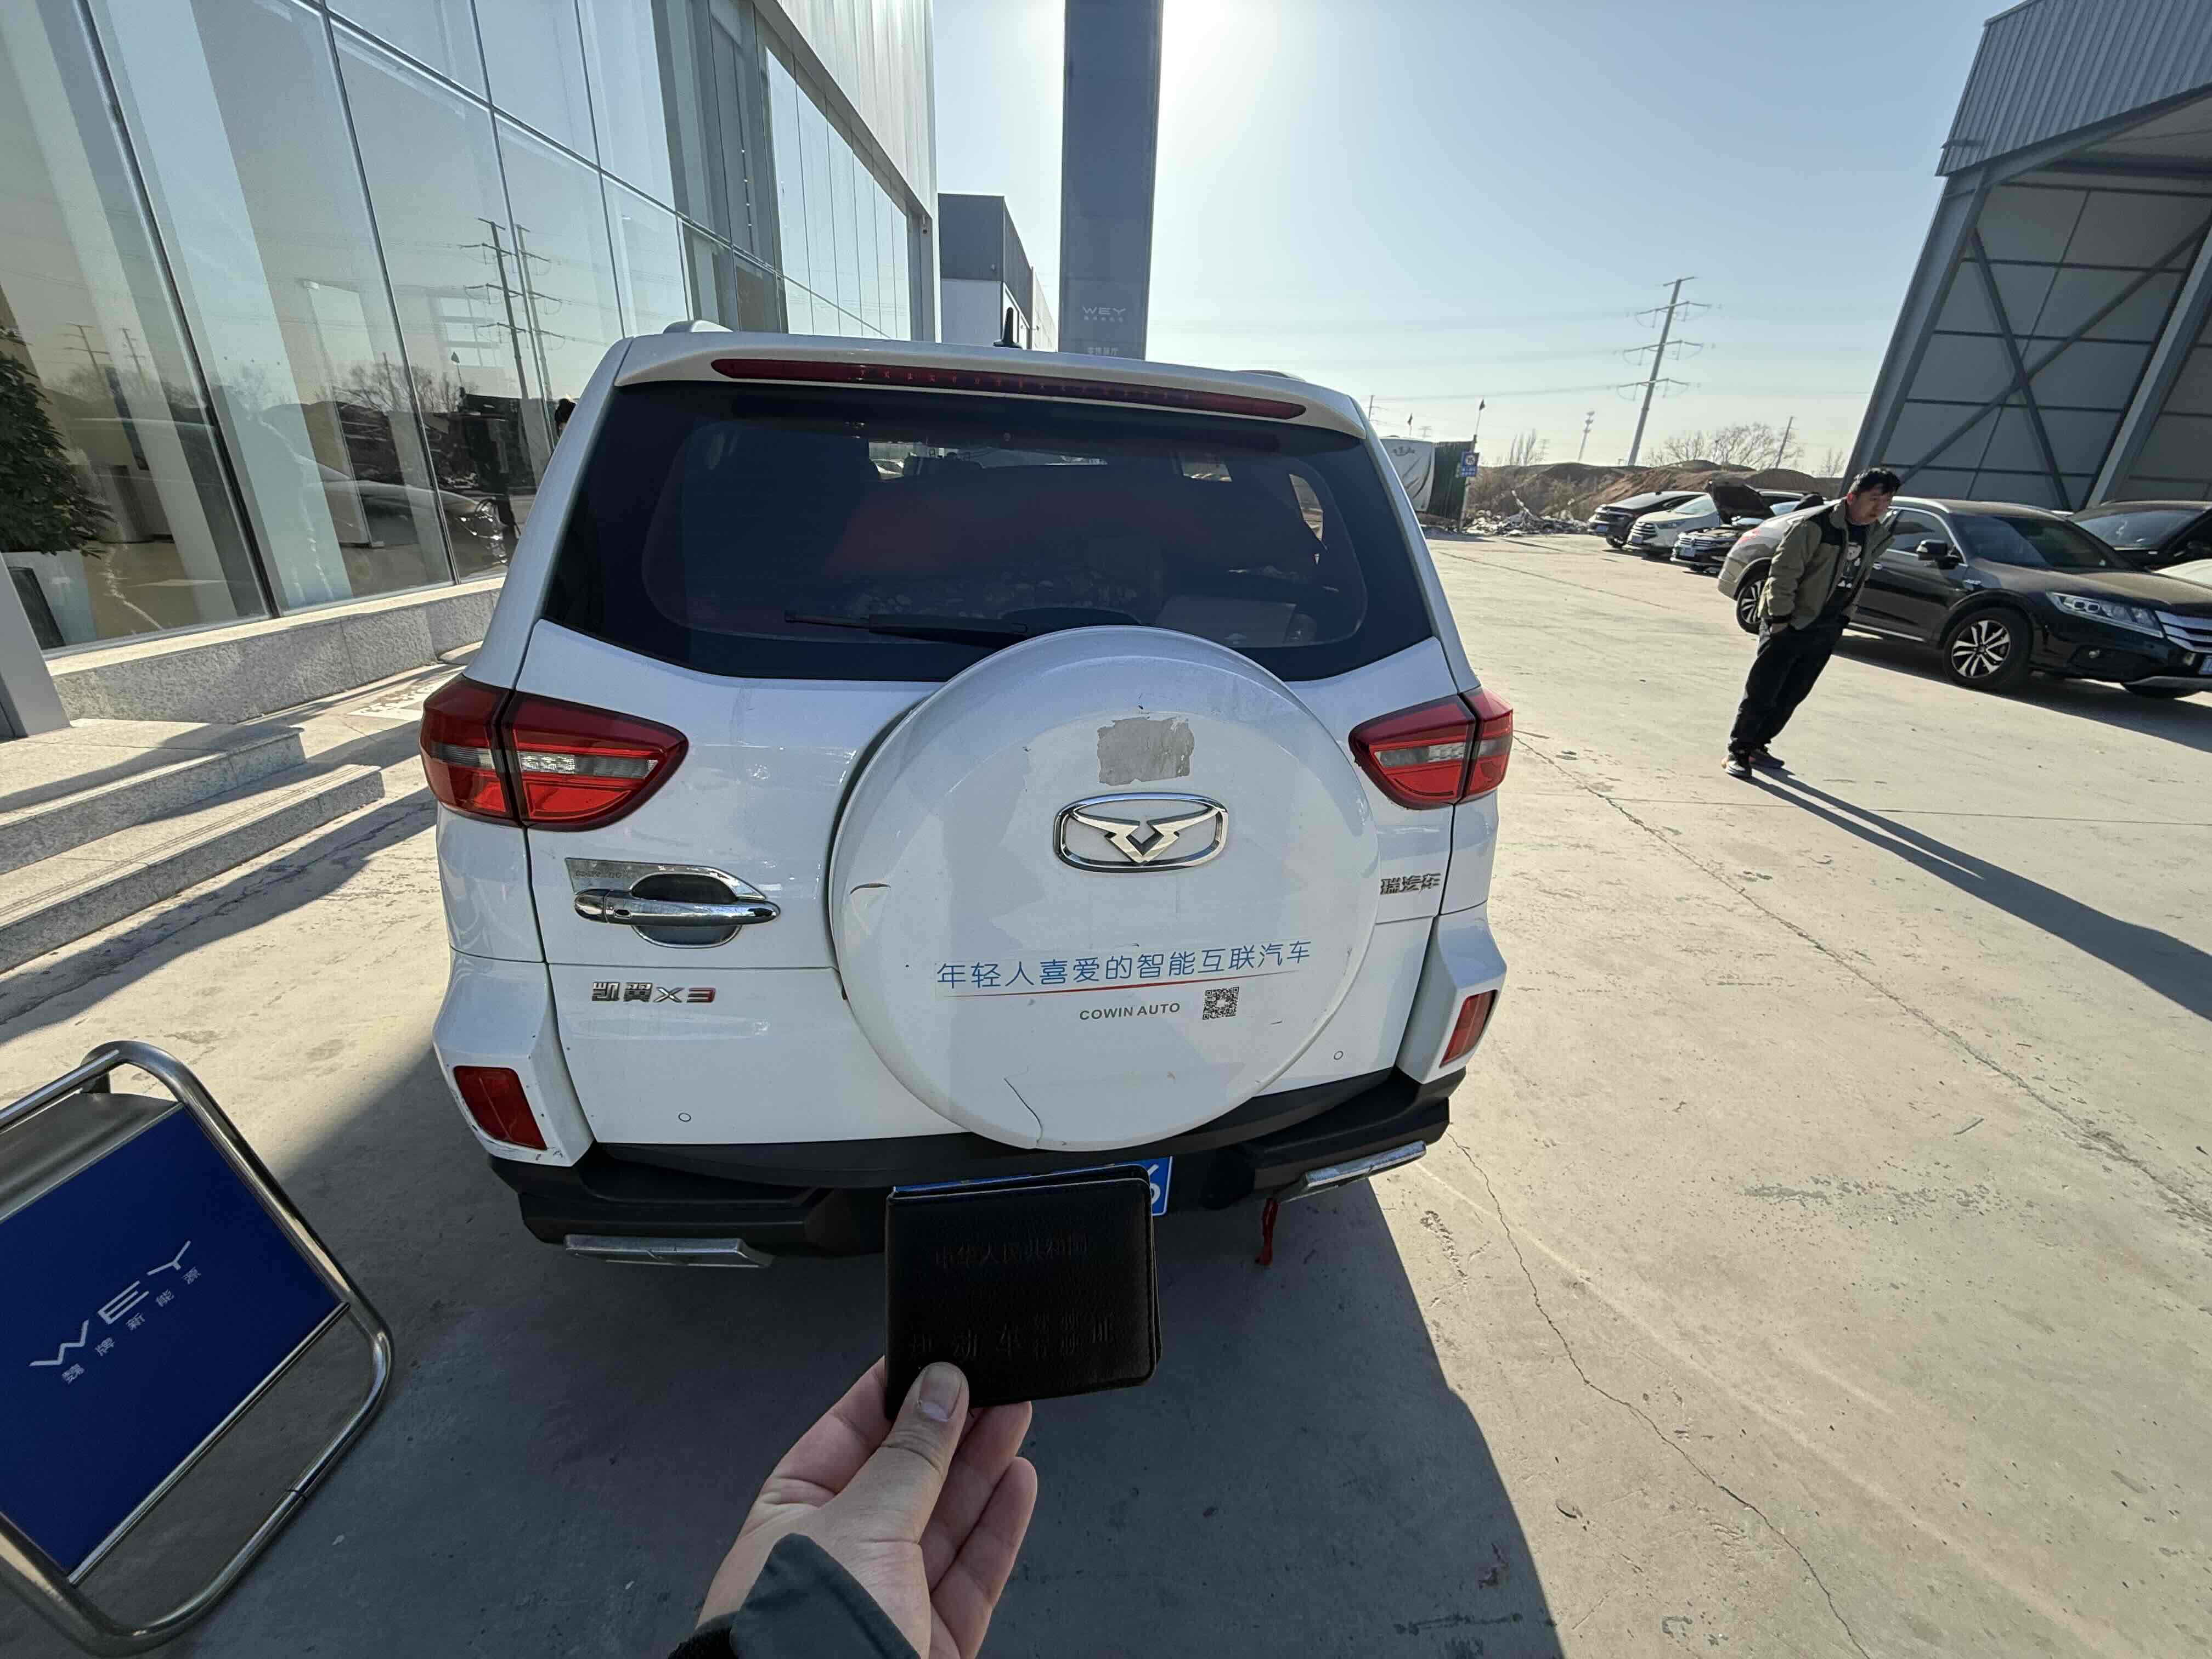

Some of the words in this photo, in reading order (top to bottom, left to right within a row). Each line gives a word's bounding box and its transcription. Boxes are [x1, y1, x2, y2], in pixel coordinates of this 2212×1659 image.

[1082, 306, 1126, 315] WEY
[936, 940, 1312, 989] 年轻人喜爱的智能互联汽车
[591, 981, 716, 1003] 凯翼X3
[1079, 1006, 1133, 1020] COWIN
[1136, 1002, 1181, 1016] AUTO
[29, 1240, 191, 1367] WEY
[61, 1267, 201, 1385] 魏牌新能源
